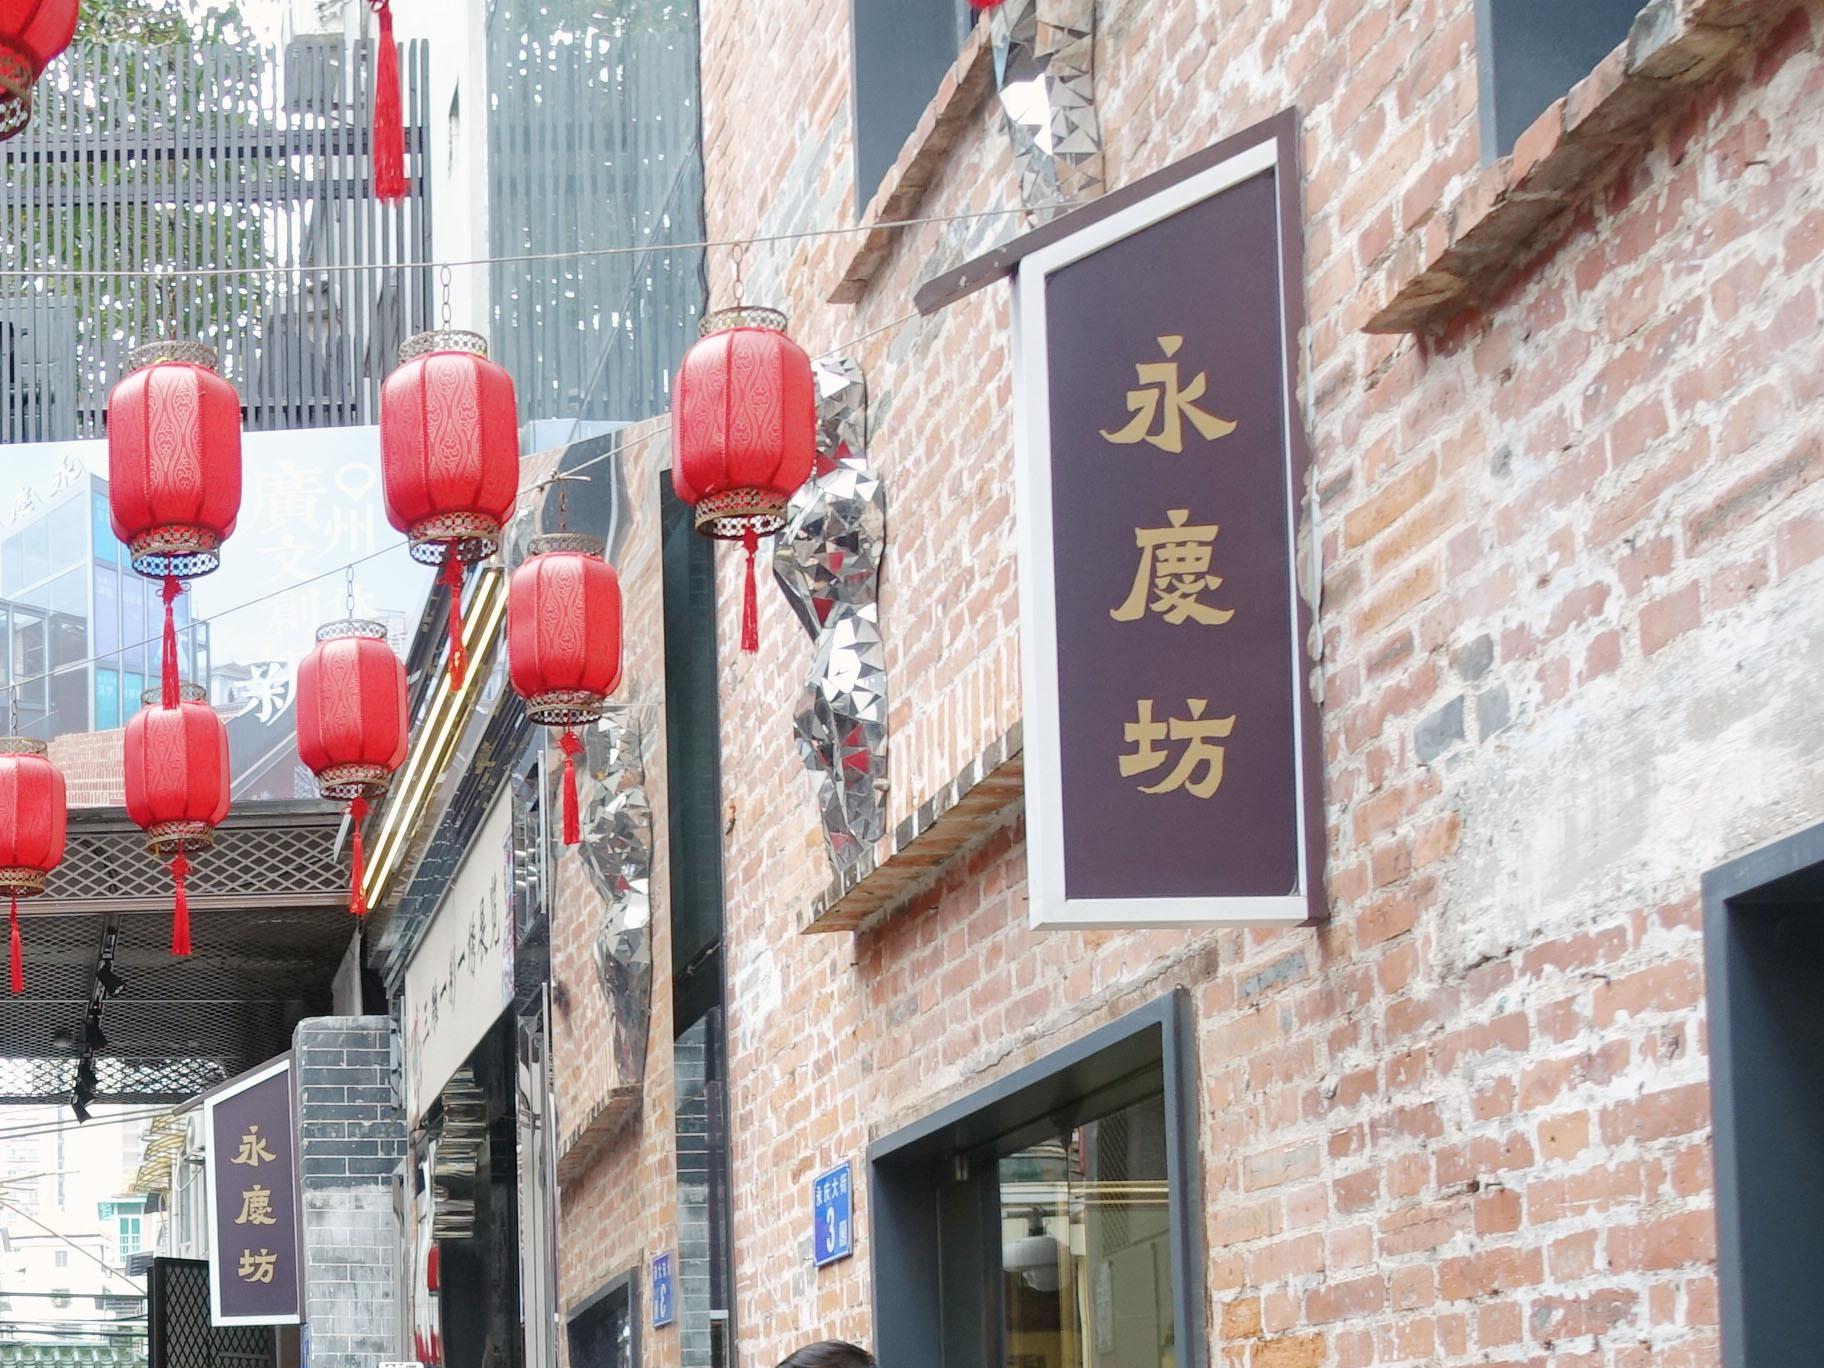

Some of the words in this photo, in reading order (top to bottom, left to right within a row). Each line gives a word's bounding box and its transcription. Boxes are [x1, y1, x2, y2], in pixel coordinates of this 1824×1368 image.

[1099, 333, 1238, 799] 永慶坊
[230, 1125, 277, 1285] 永慶坊
[826, 1206, 836, 1254] 3
